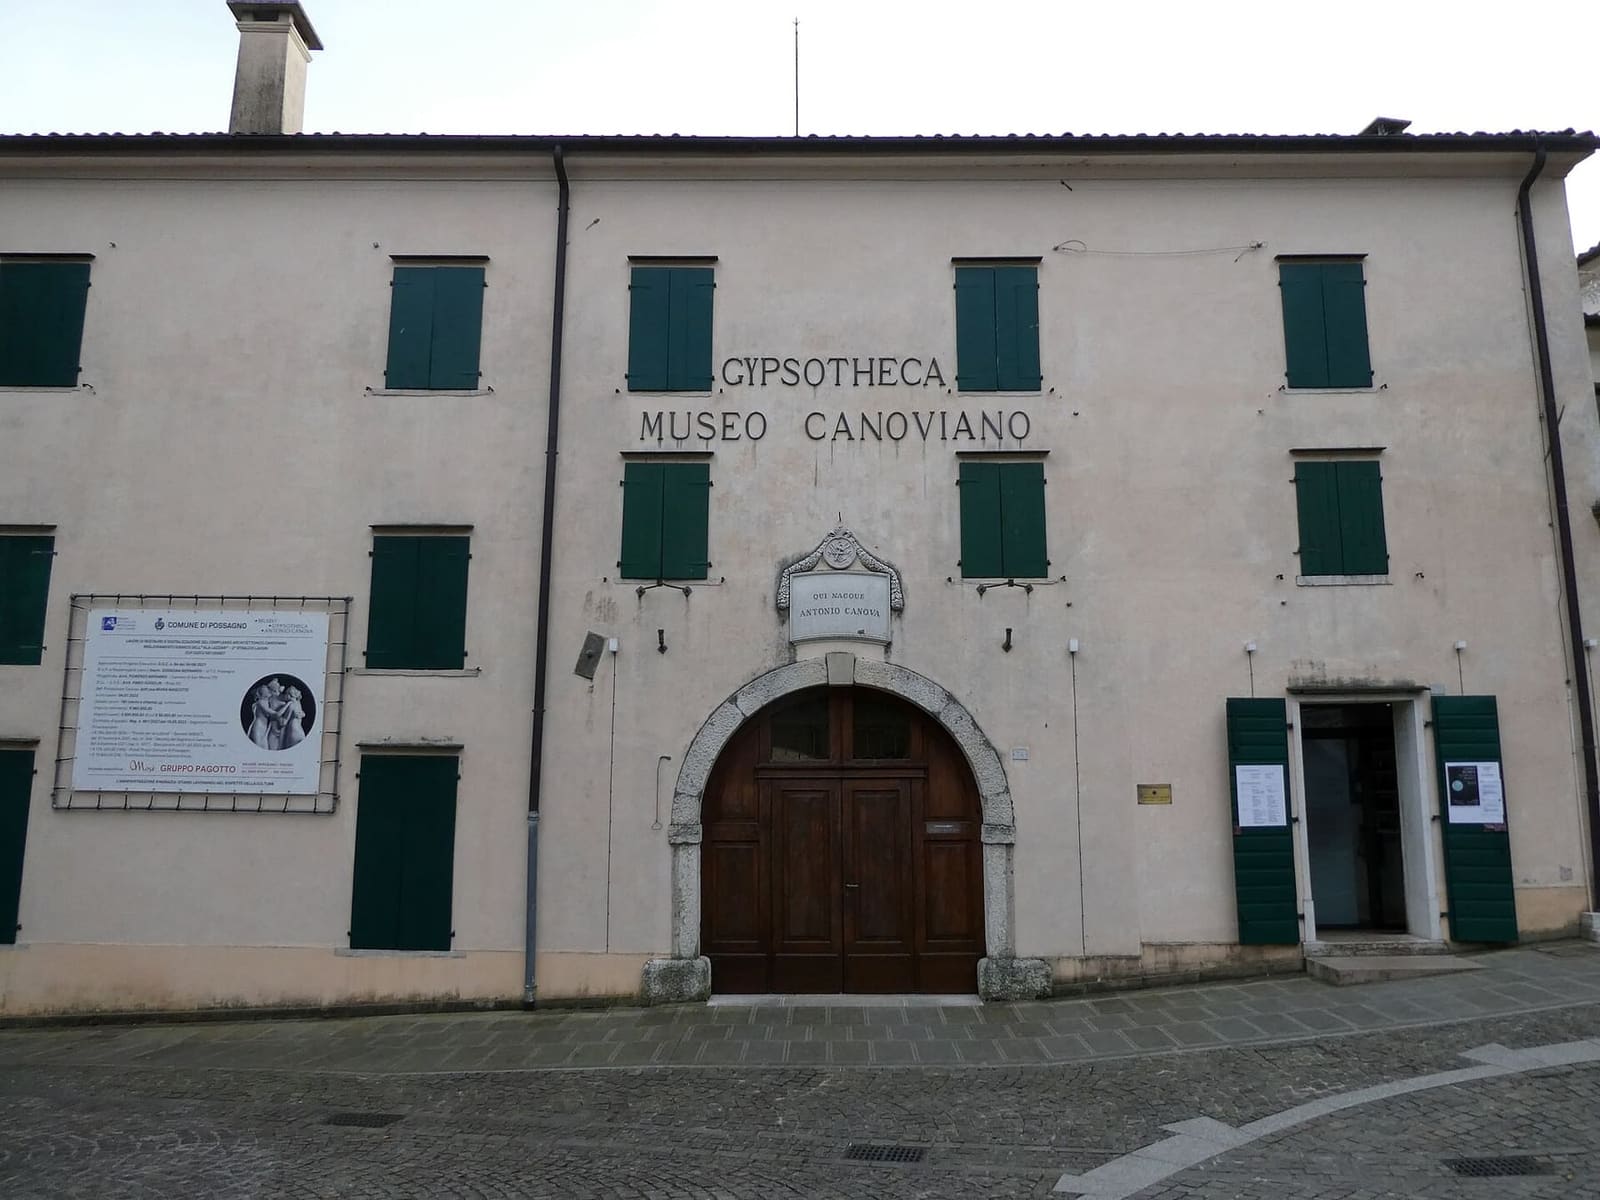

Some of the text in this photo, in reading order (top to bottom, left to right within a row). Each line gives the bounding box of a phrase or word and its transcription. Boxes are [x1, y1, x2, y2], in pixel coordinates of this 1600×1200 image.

[721, 356, 947, 388] GYPSOTHECA
[639, 410, 1032, 442] MUSEO CANOVIANO
[799, 607, 881, 618] ANTONIO CANOVA
[167, 621, 248, 631] COMUNE DI POSSAGNO
[159, 764, 194, 773] GRUPPO
[194, 764, 237, 774] PAGOTTO
